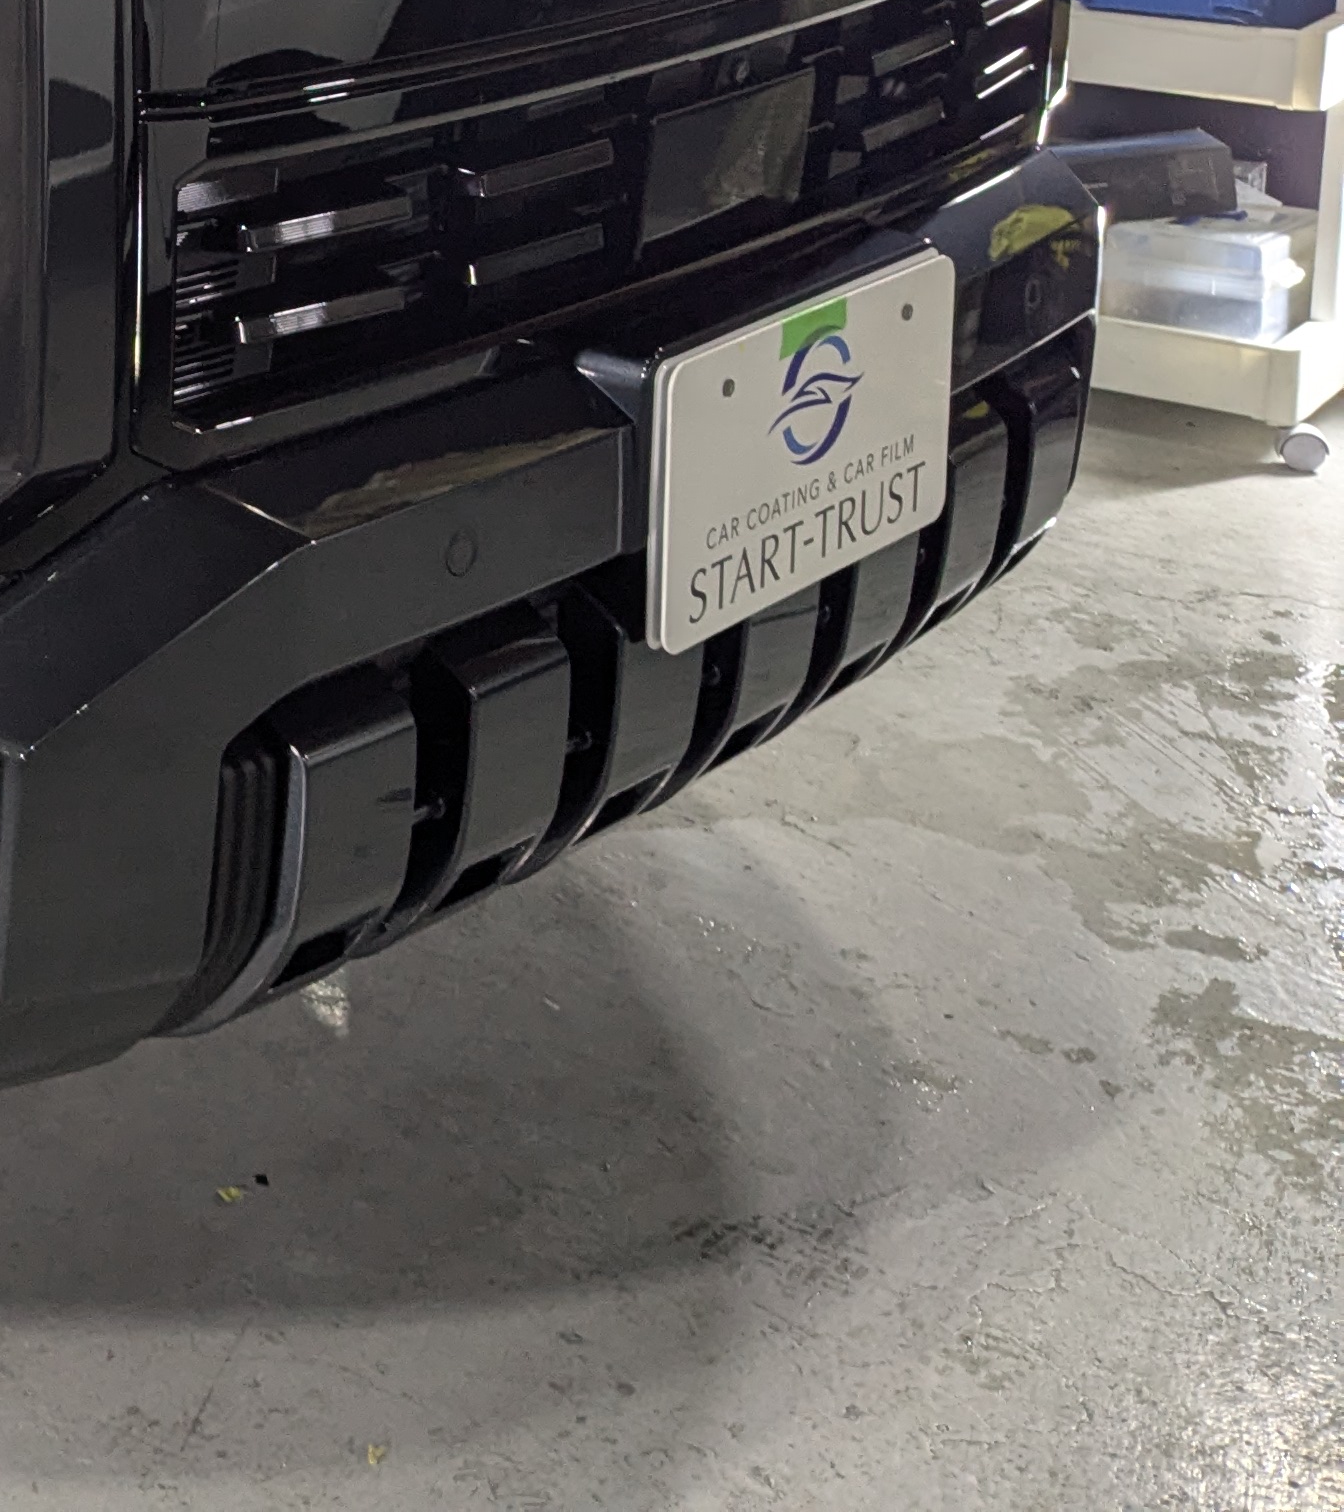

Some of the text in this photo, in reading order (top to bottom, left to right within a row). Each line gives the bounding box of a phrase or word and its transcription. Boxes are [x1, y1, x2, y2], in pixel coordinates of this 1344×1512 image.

[688, 461, 926, 624] START-TRUST
[706, 434, 915, 550] CAR COATING & CAR FILM
